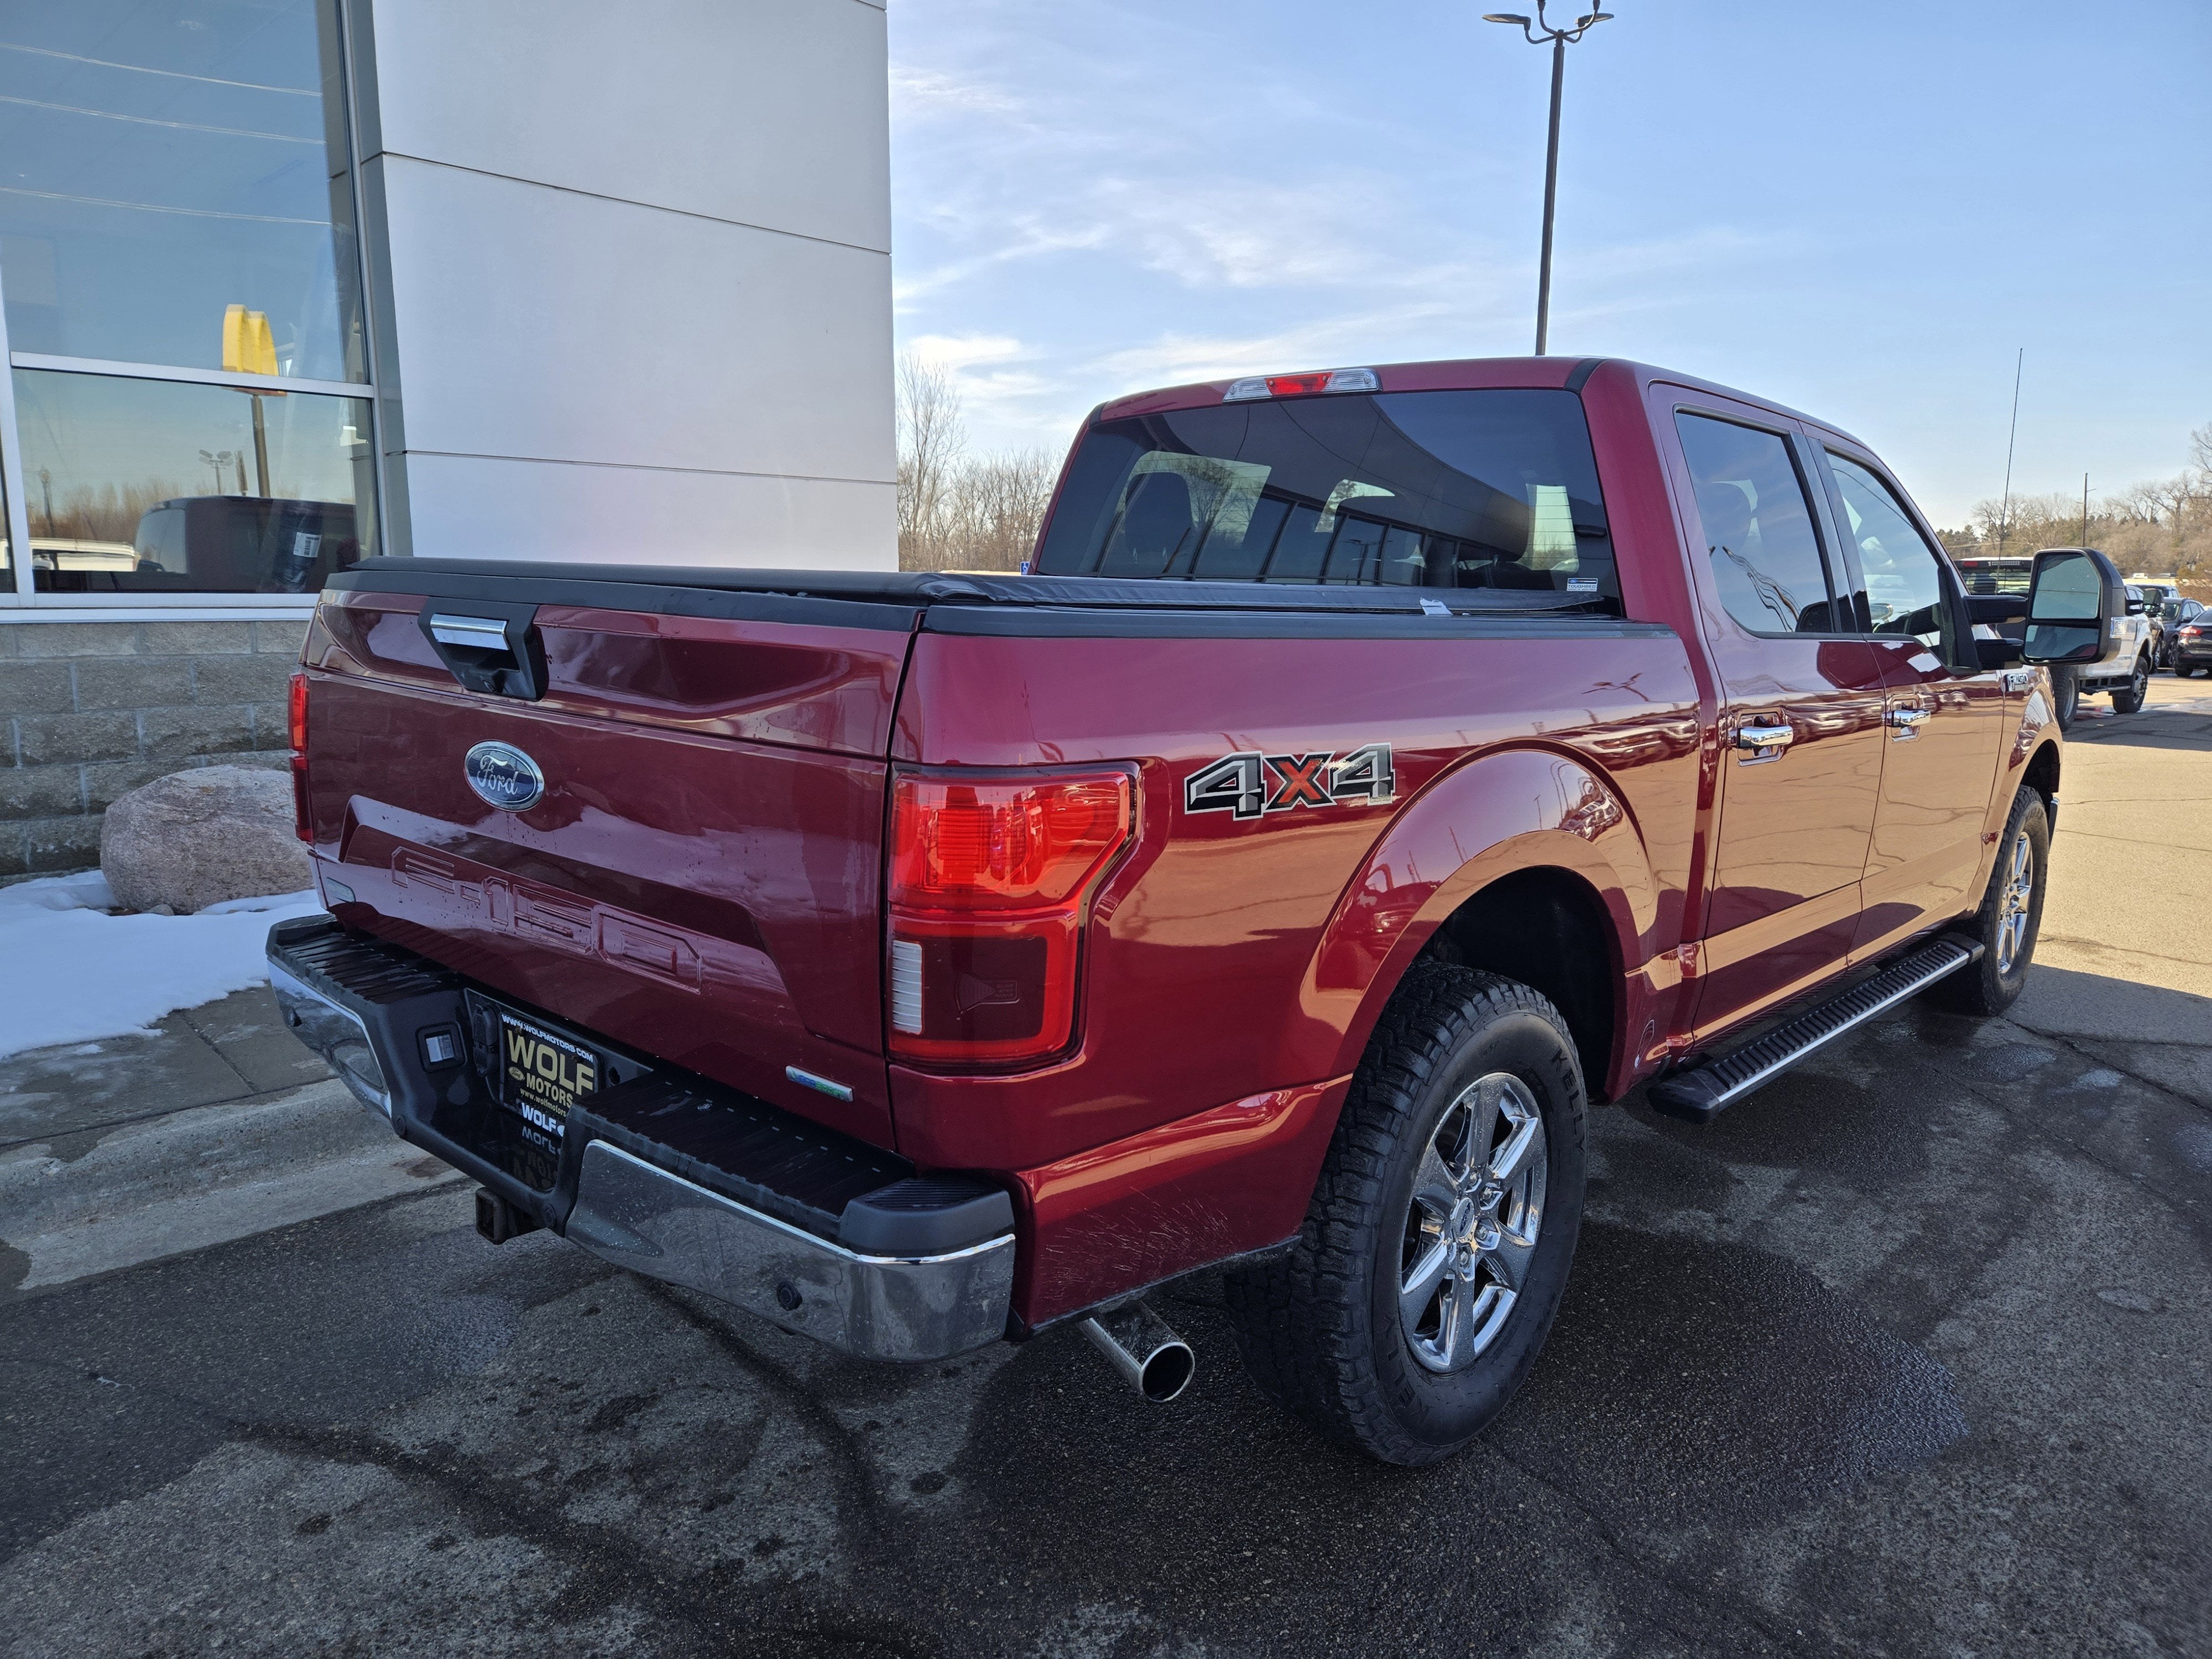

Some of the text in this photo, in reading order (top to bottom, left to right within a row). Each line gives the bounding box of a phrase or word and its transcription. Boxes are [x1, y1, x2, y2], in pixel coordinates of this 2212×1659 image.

[477, 754, 519, 795] Ford
[502, 1014, 593, 1062] WWW.WOLFMOTORSCOM
[508, 1029, 594, 1095] WOLF
[526, 1072, 573, 1109] MOTORS
[1549, 1045, 1585, 1157] KELLY
[521, 1102, 556, 1132] WOLF
